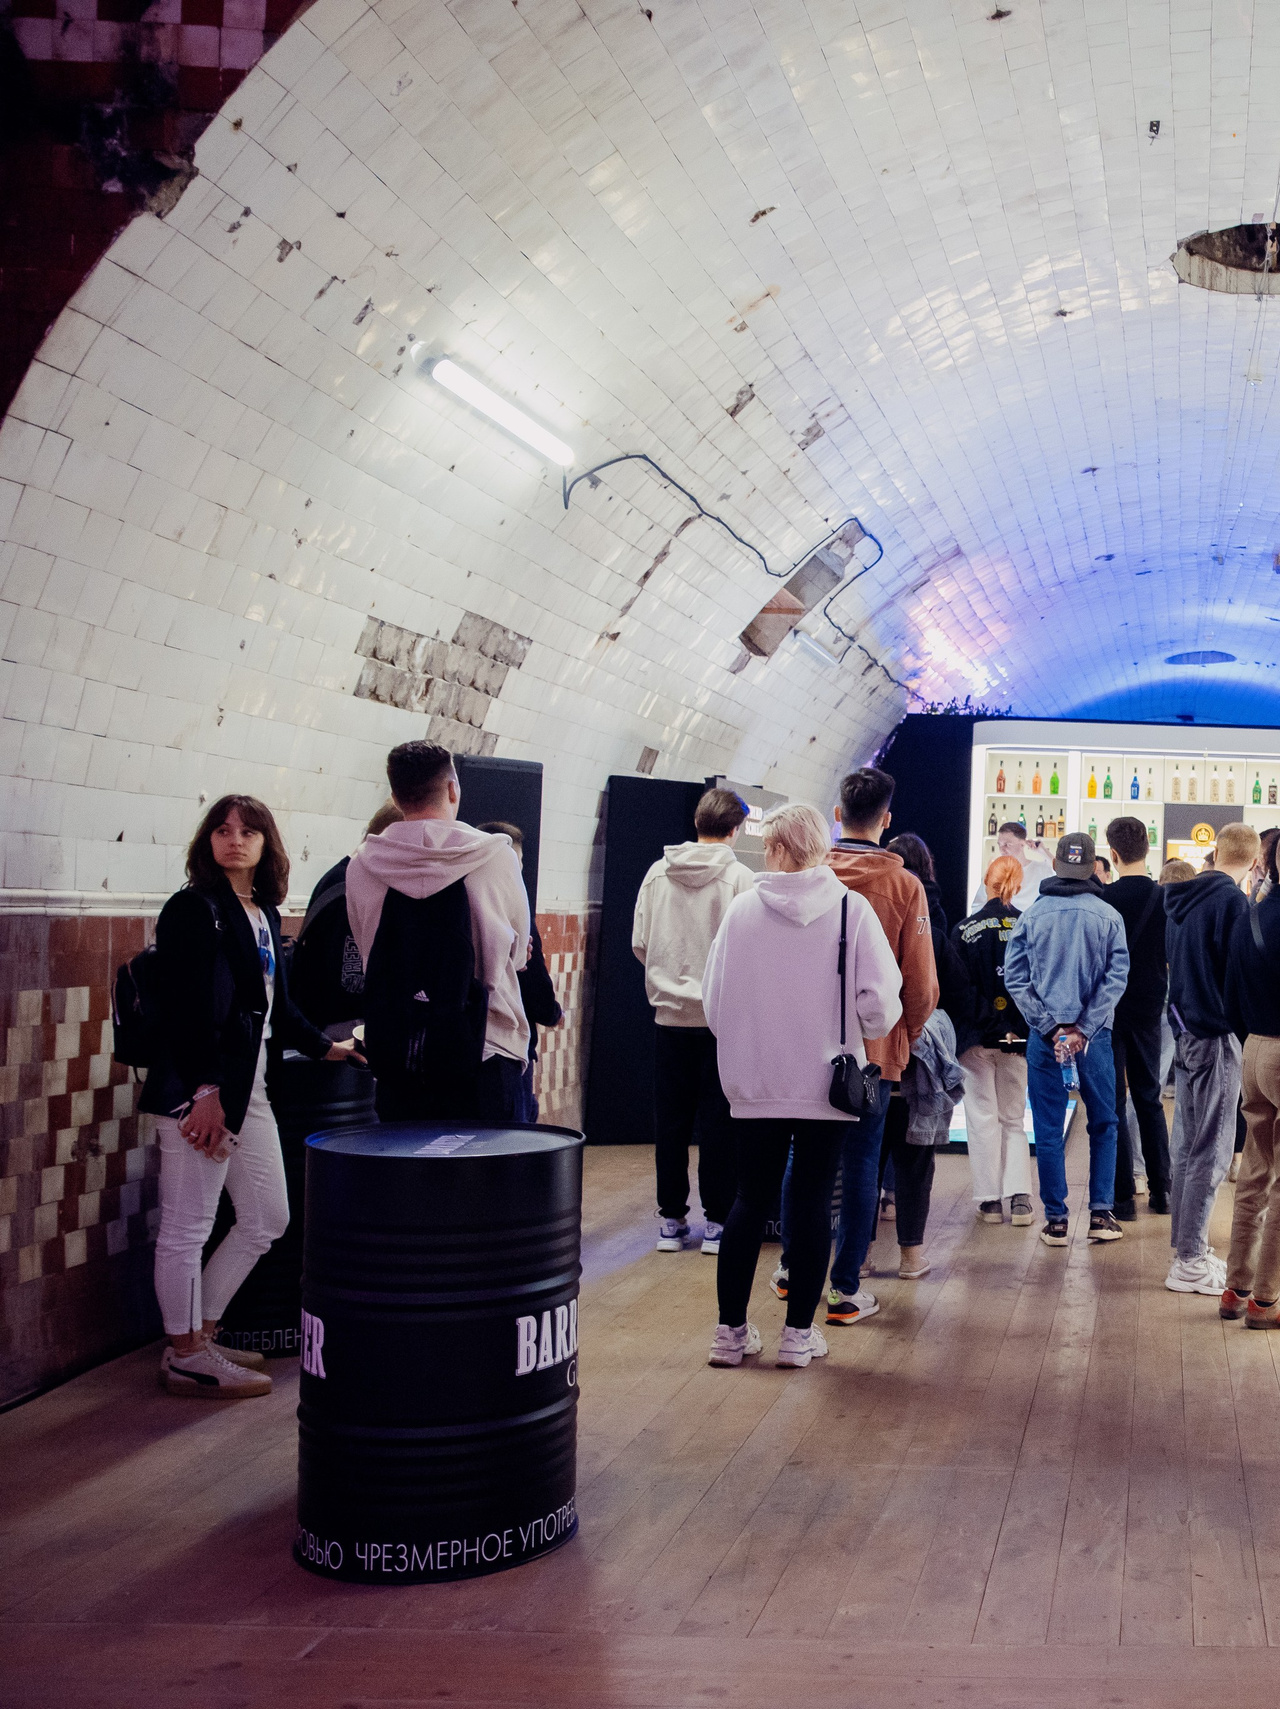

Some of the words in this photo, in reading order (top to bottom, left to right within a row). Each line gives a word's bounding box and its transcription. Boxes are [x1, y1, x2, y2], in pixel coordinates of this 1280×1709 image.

[301, 1307, 327, 1380] ER
[515, 1298, 578, 1377] BARR
[567, 1360, 576, 1387] G
[299, 1525, 343, 1570] ОВЬЮ
[356, 1529, 513, 1572] ЧРЕЗМЕРНОЕ
[518, 1496, 575, 1552] УПОТРЕБ
